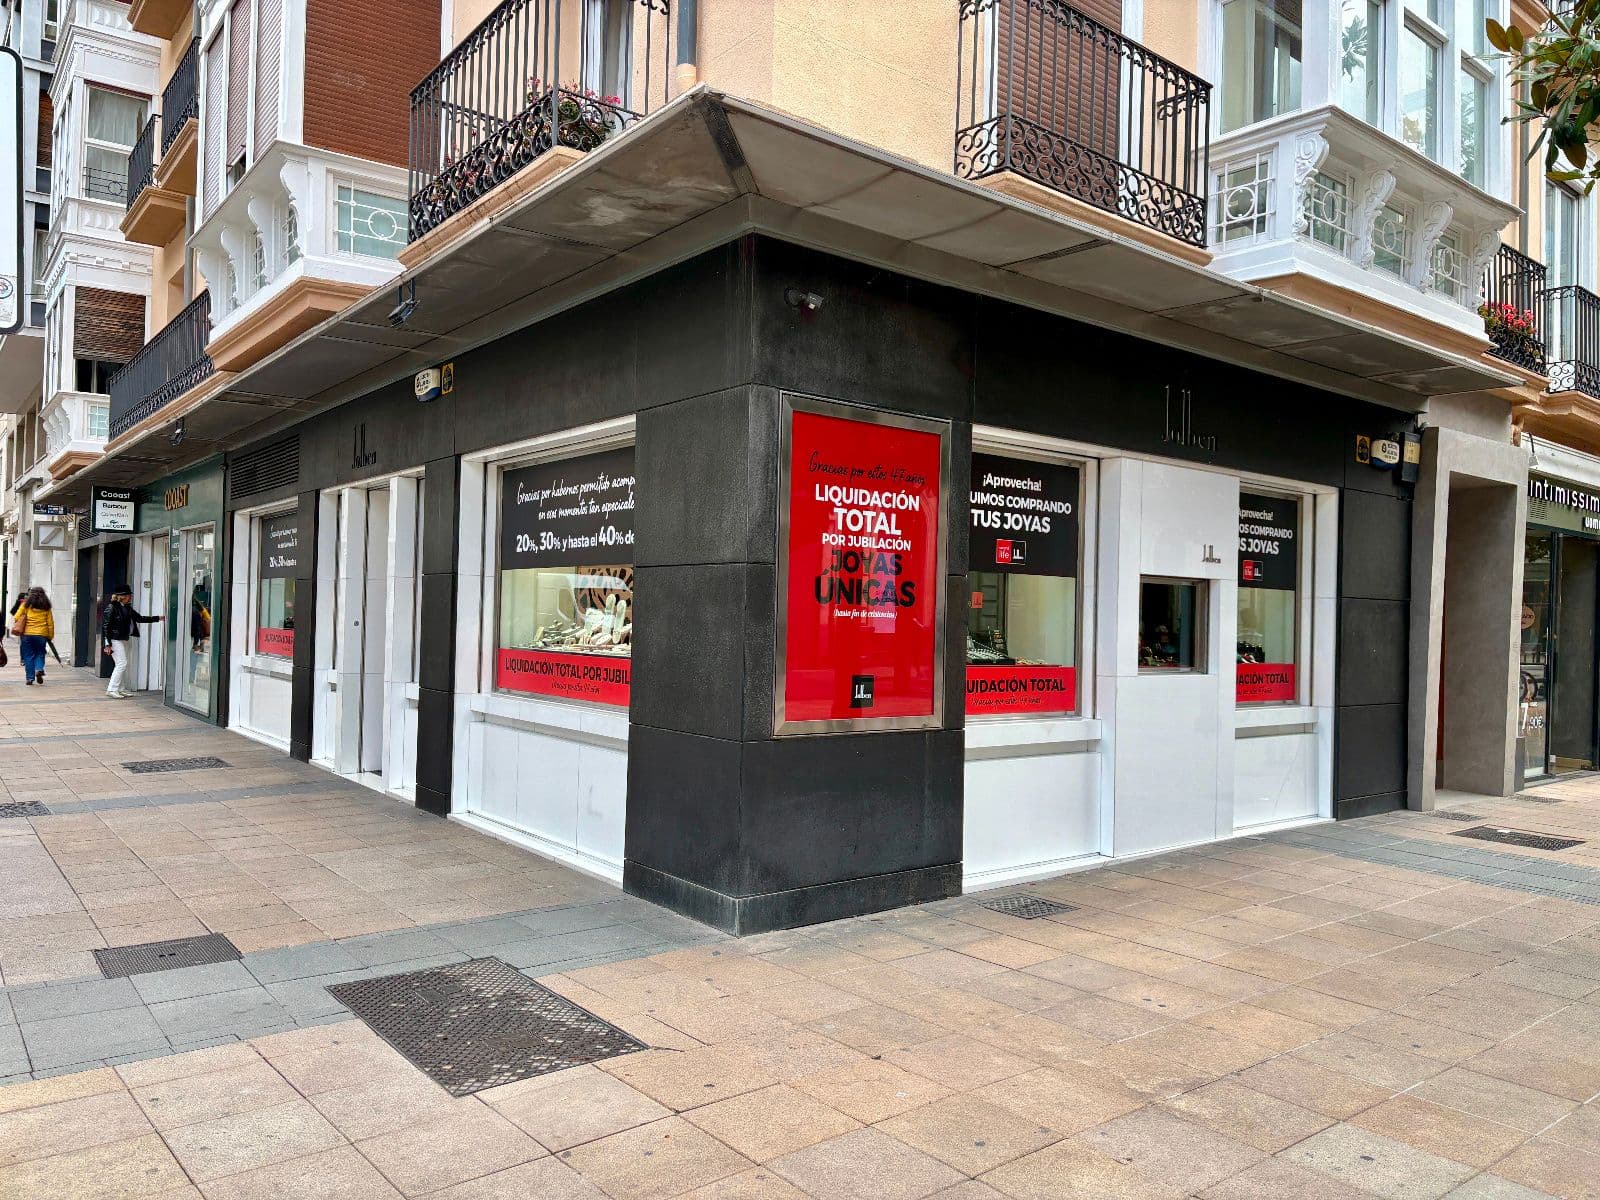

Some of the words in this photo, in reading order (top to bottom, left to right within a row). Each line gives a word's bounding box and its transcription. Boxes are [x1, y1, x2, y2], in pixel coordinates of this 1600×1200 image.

[809, 450, 848, 476] Gracias
[850, 466, 864, 482] por
[867, 464, 887, 480] estos
[517, 482, 541, 505] Gracias
[540, 489, 552, 507] por
[552, 479, 580, 498] habernos
[579, 472, 611, 500] permitido
[983, 473, 1042, 491] ¡Aprovecha!
[538, 511, 546, 520] en
[559, 499, 588, 518] momentos
[589, 498, 600, 514] tan
[815, 483, 920, 511] LIQUIDACIÓN
[970, 491, 1004, 506] UIMOS
[1006, 496, 1072, 514] COMPRANDO
[833, 507, 902, 535] TOTAL
[971, 509, 1001, 528] TUS
[1003, 512, 1051, 533] JOYAS
[1250, 525, 1293, 539] COMPRANDO
[516, 534, 538, 553] 20%,
[540, 531, 561, 551] 30%
[562, 540, 568, 552] y
[568, 535, 589, 548] hasta
[590, 533, 598, 546] el
[599, 525, 624, 546] 40%
[822, 533, 846, 547] POR
[847, 535, 911, 551] JUBILACIÓN
[1247, 539, 1279, 555] JOYAS
[831, 549, 903, 576] JOYAS
[815, 568, 916, 608] ÚNICAS
[505, 658, 554, 675] LIQUIDACIÓN
[555, 663, 581, 679] TOTAL
[583, 666, 602, 681] POR
[603, 668, 630, 684] JUBIL
[1238, 672, 1264, 684] ACIÓN
[1266, 673, 1289, 684] TOTAL
[967, 675, 1027, 693] UIDACIÓN
[1030, 679, 1066, 692] TOTAL
